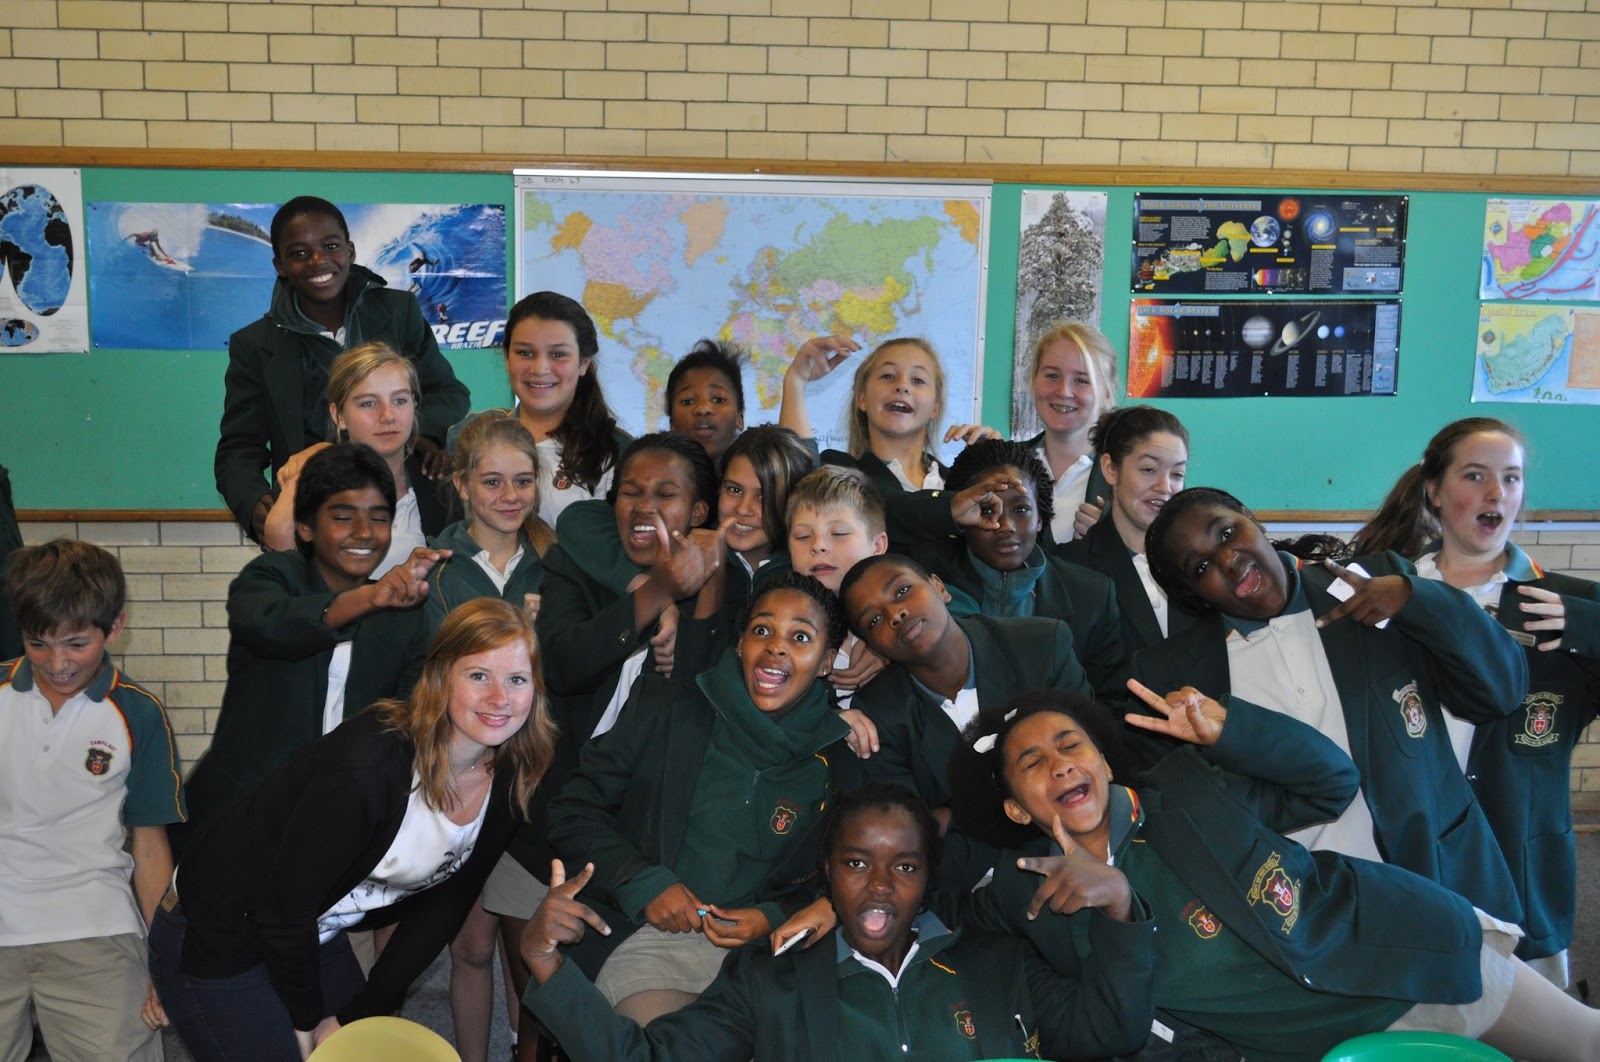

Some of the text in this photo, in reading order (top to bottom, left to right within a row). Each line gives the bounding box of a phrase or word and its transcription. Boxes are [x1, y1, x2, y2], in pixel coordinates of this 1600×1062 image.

[1160, 306, 1184, 315] SOLAR
[1187, 306, 1216, 315] SYSTEM
[430, 320, 507, 348] REEF
